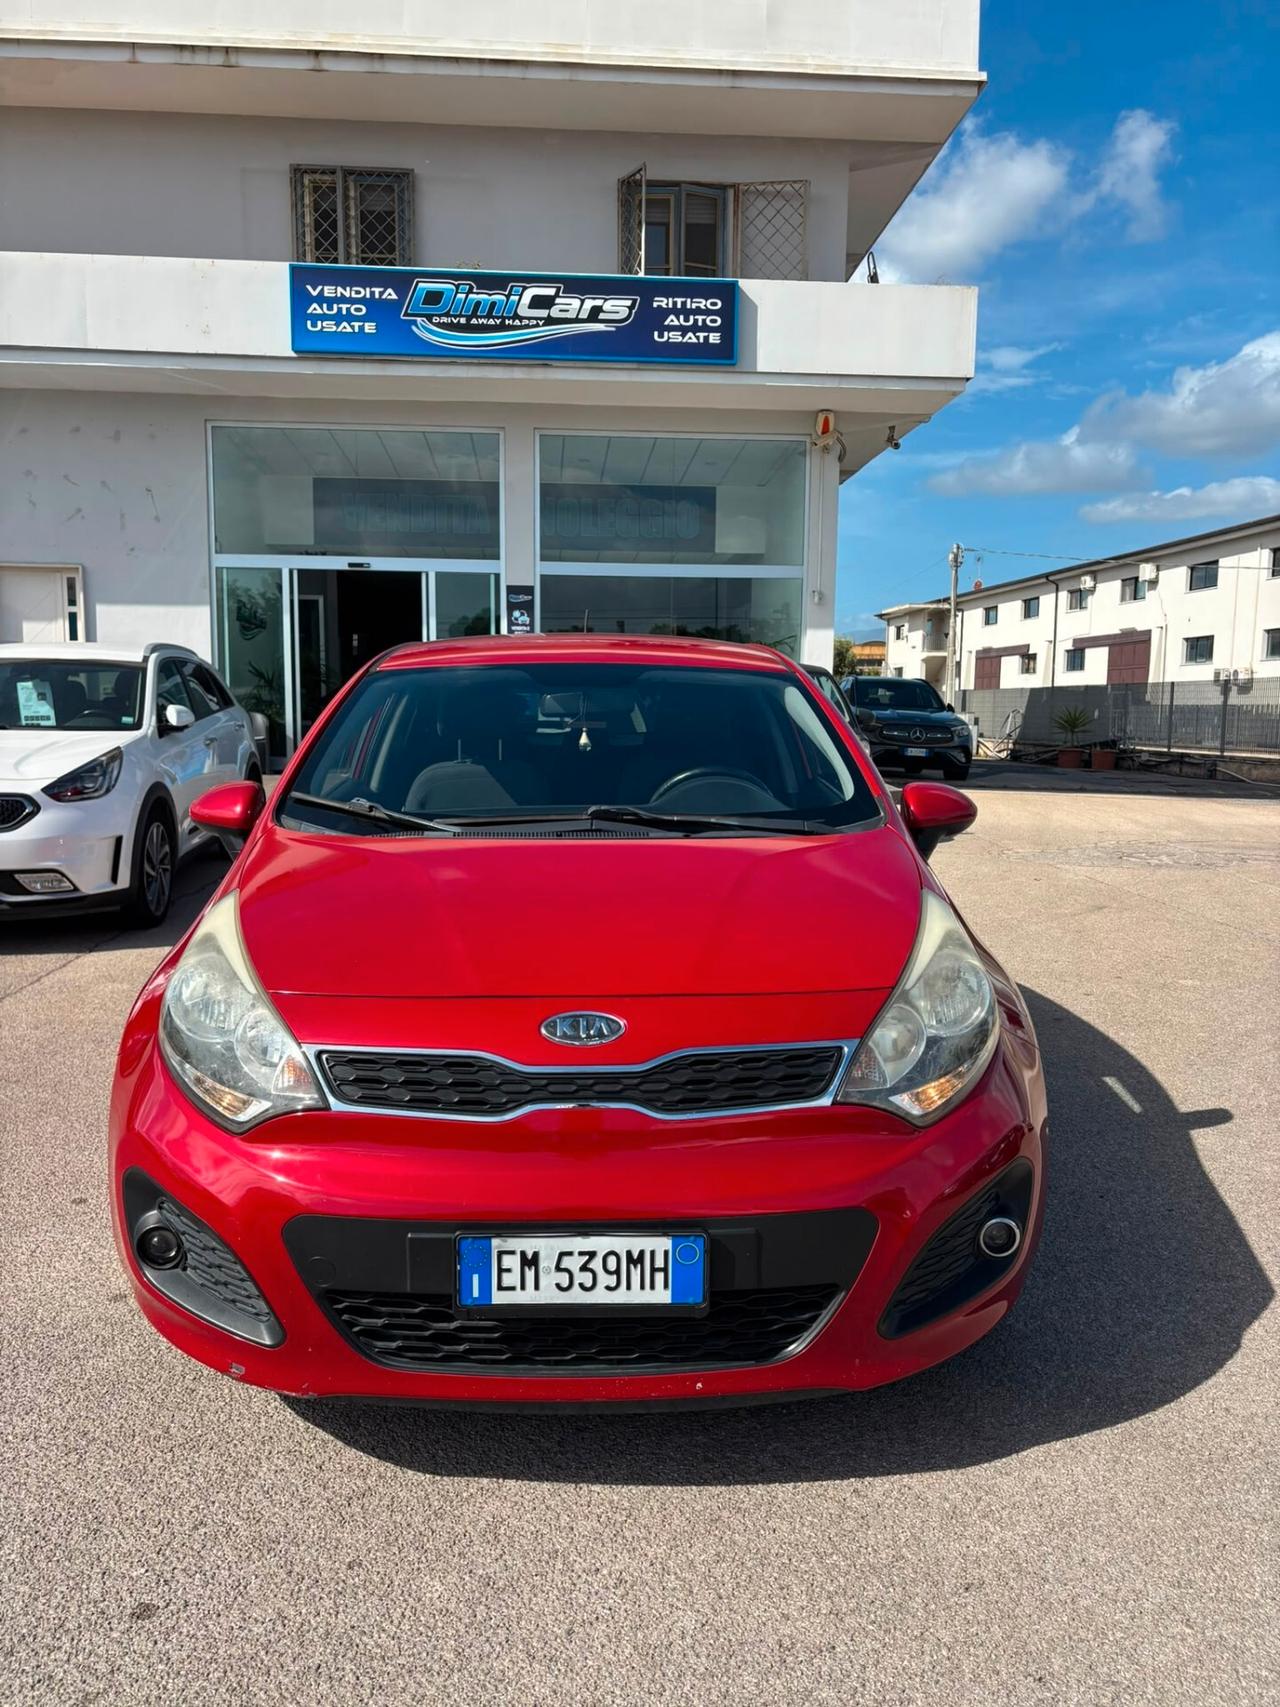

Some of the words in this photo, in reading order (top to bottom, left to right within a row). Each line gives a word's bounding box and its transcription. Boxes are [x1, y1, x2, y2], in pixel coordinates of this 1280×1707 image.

[305, 284, 399, 300] VENDITA
[407, 282, 633, 320] DimiCars
[652, 297, 722, 310] RITIRO
[306, 302, 367, 316] AUTO
[306, 320, 377, 334] USATE
[432, 316, 467, 324] DRIVE
[663, 314, 722, 327] AUTO
[653, 331, 722, 344] USATE
[556, 1017, 611, 1038] KIA
[496, 1249, 540, 1292] EM
[554, 1248, 670, 1292] 539MH
